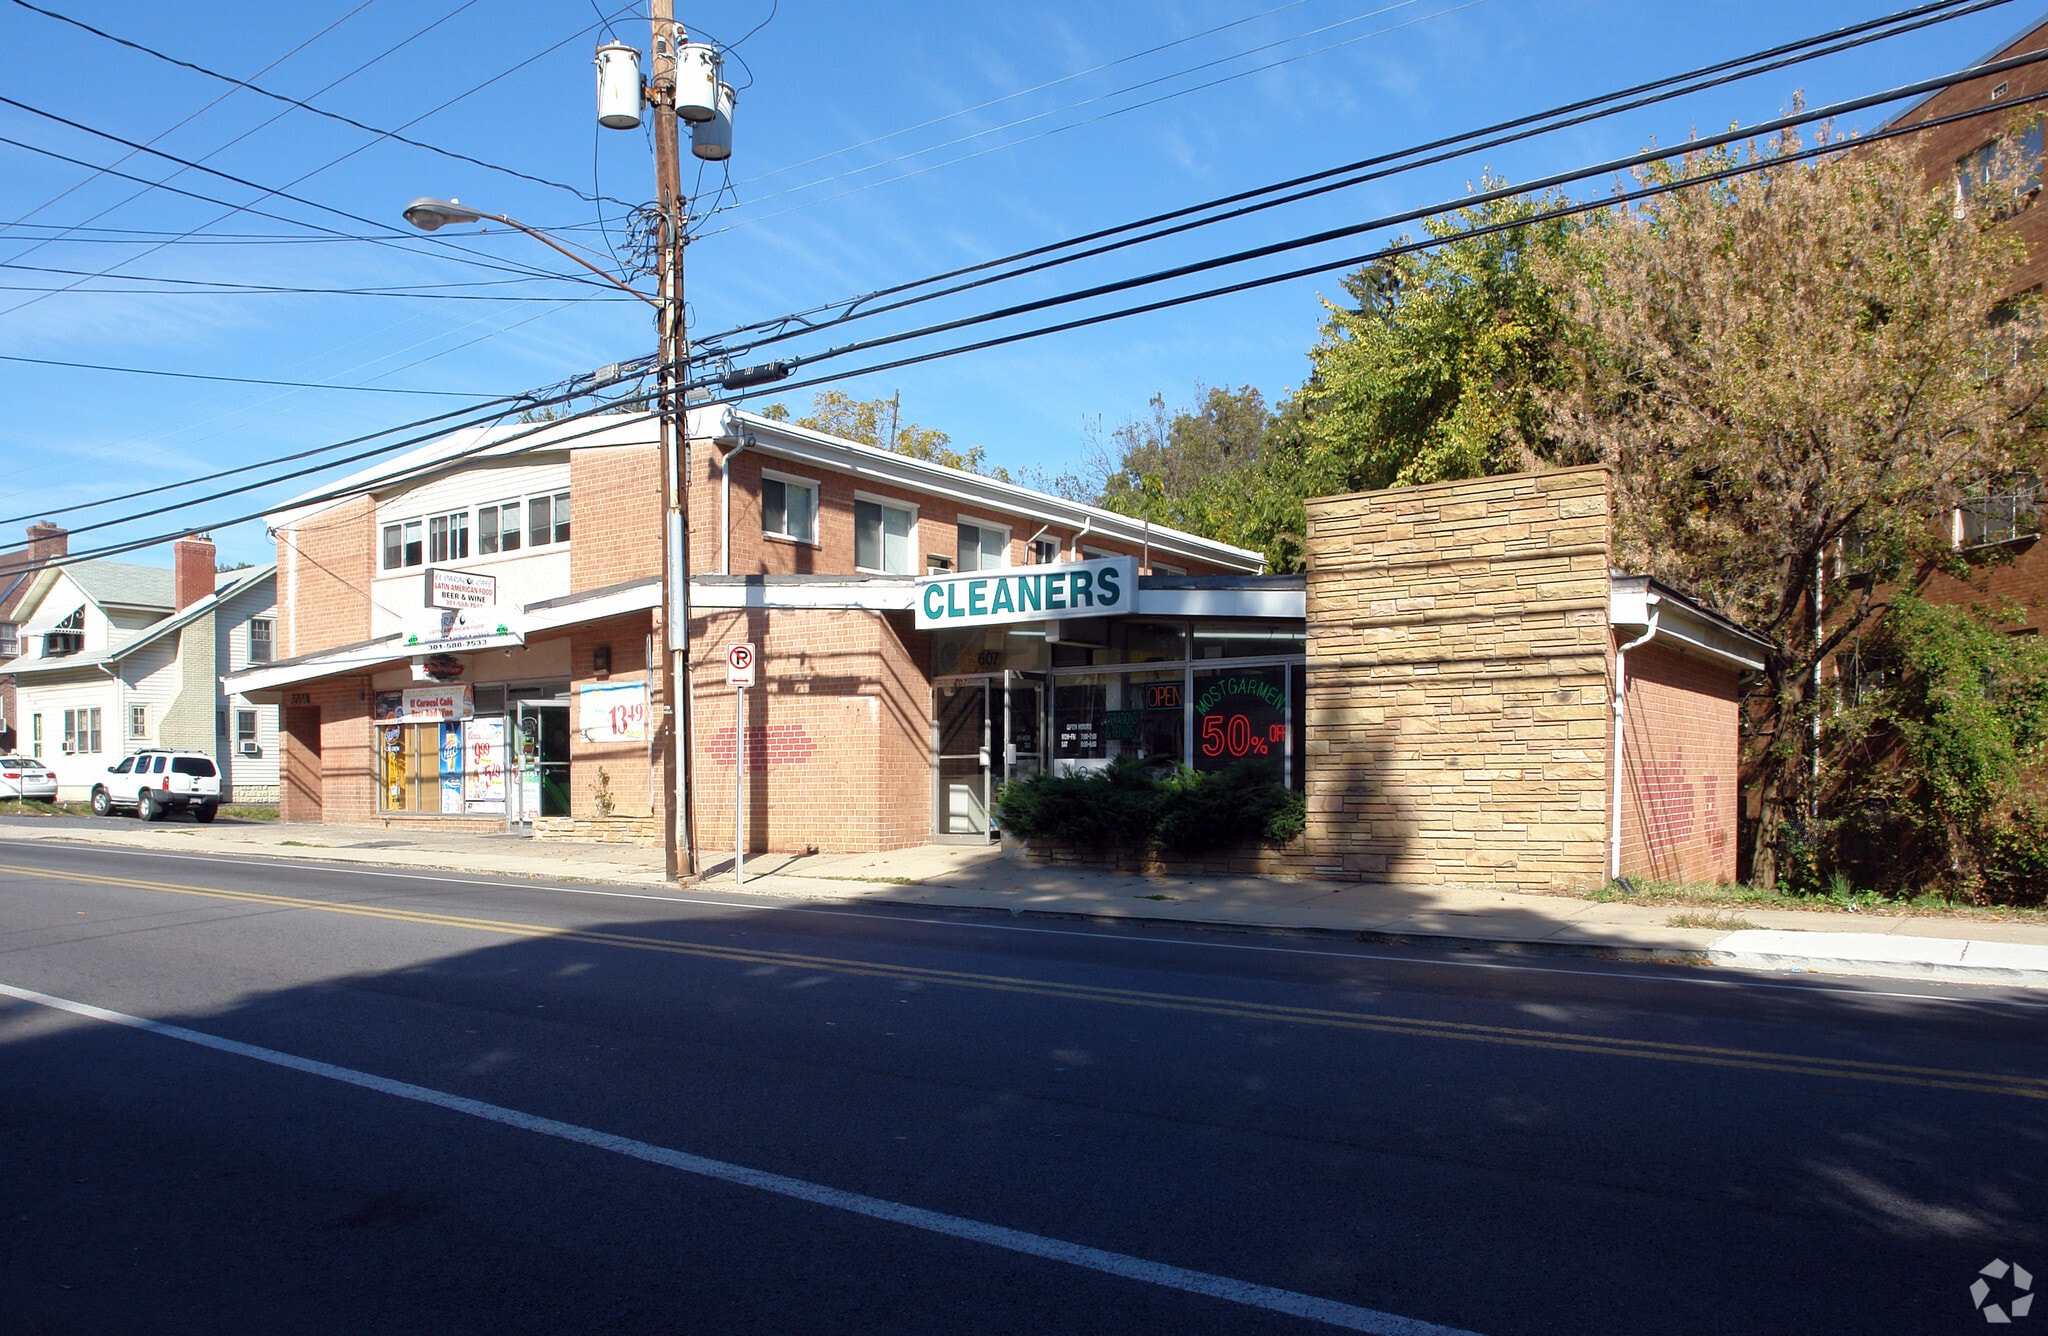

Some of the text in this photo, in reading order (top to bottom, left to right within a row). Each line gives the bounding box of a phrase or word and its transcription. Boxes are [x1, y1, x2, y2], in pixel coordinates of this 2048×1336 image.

[435, 582, 493, 596] LATIN AMERICAN FOOD
[923, 567, 1120, 620] CLEANERS
[441, 591, 486, 604] BEER & WINE
[428, 639, 487, 651] 301-588-7533
[977, 652, 1000, 666] 607
[954, 679, 968, 688] 607
[416, 698, 439, 708] Caracol
[1147, 686, 1183, 708] OPEN
[411, 708, 454, 718] Beer And Wine
[1066, 723, 1077, 731] OPEN
[1202, 713, 1269, 757] 50%
